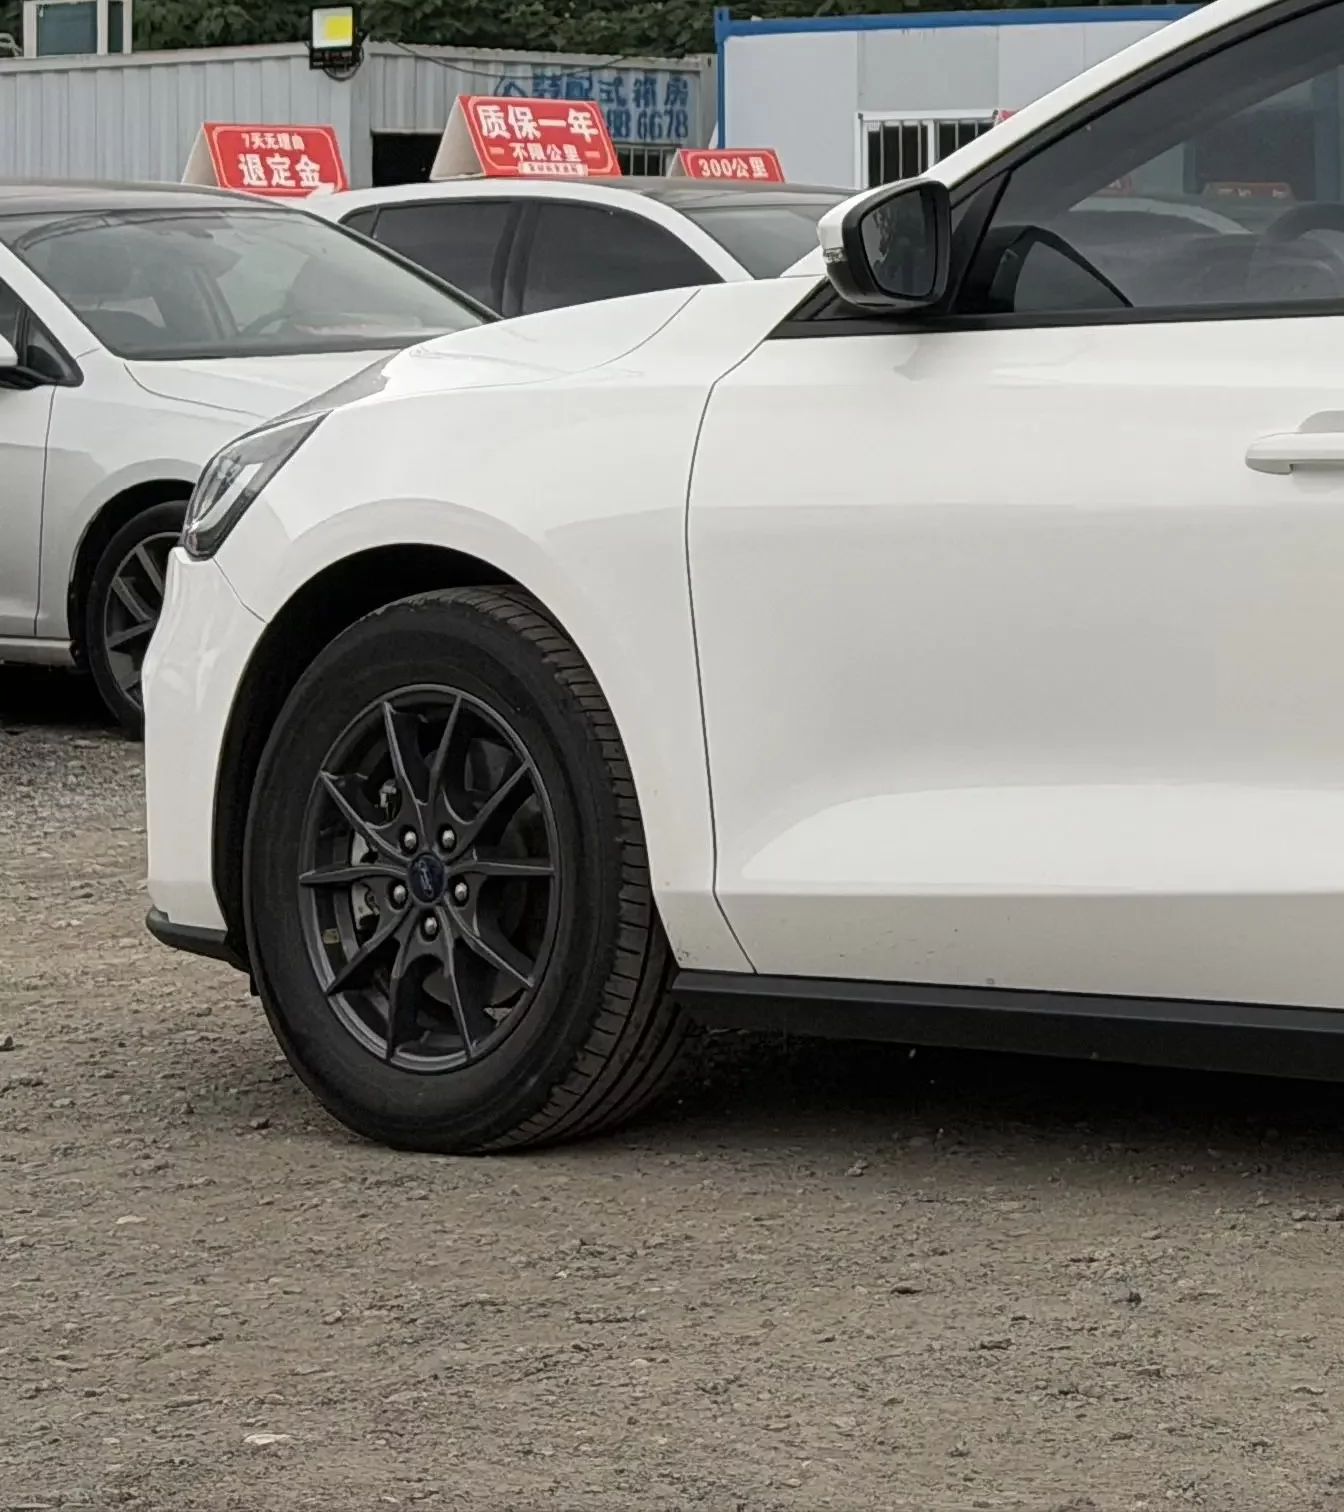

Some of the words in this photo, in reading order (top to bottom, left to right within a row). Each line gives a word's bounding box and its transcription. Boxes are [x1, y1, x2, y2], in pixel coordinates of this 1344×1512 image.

[476, 104, 598, 142] 质保一年
[508, 142, 582, 162] 不限公里
[237, 153, 321, 187] 退定金
[699, 156, 769, 178] 300公里
